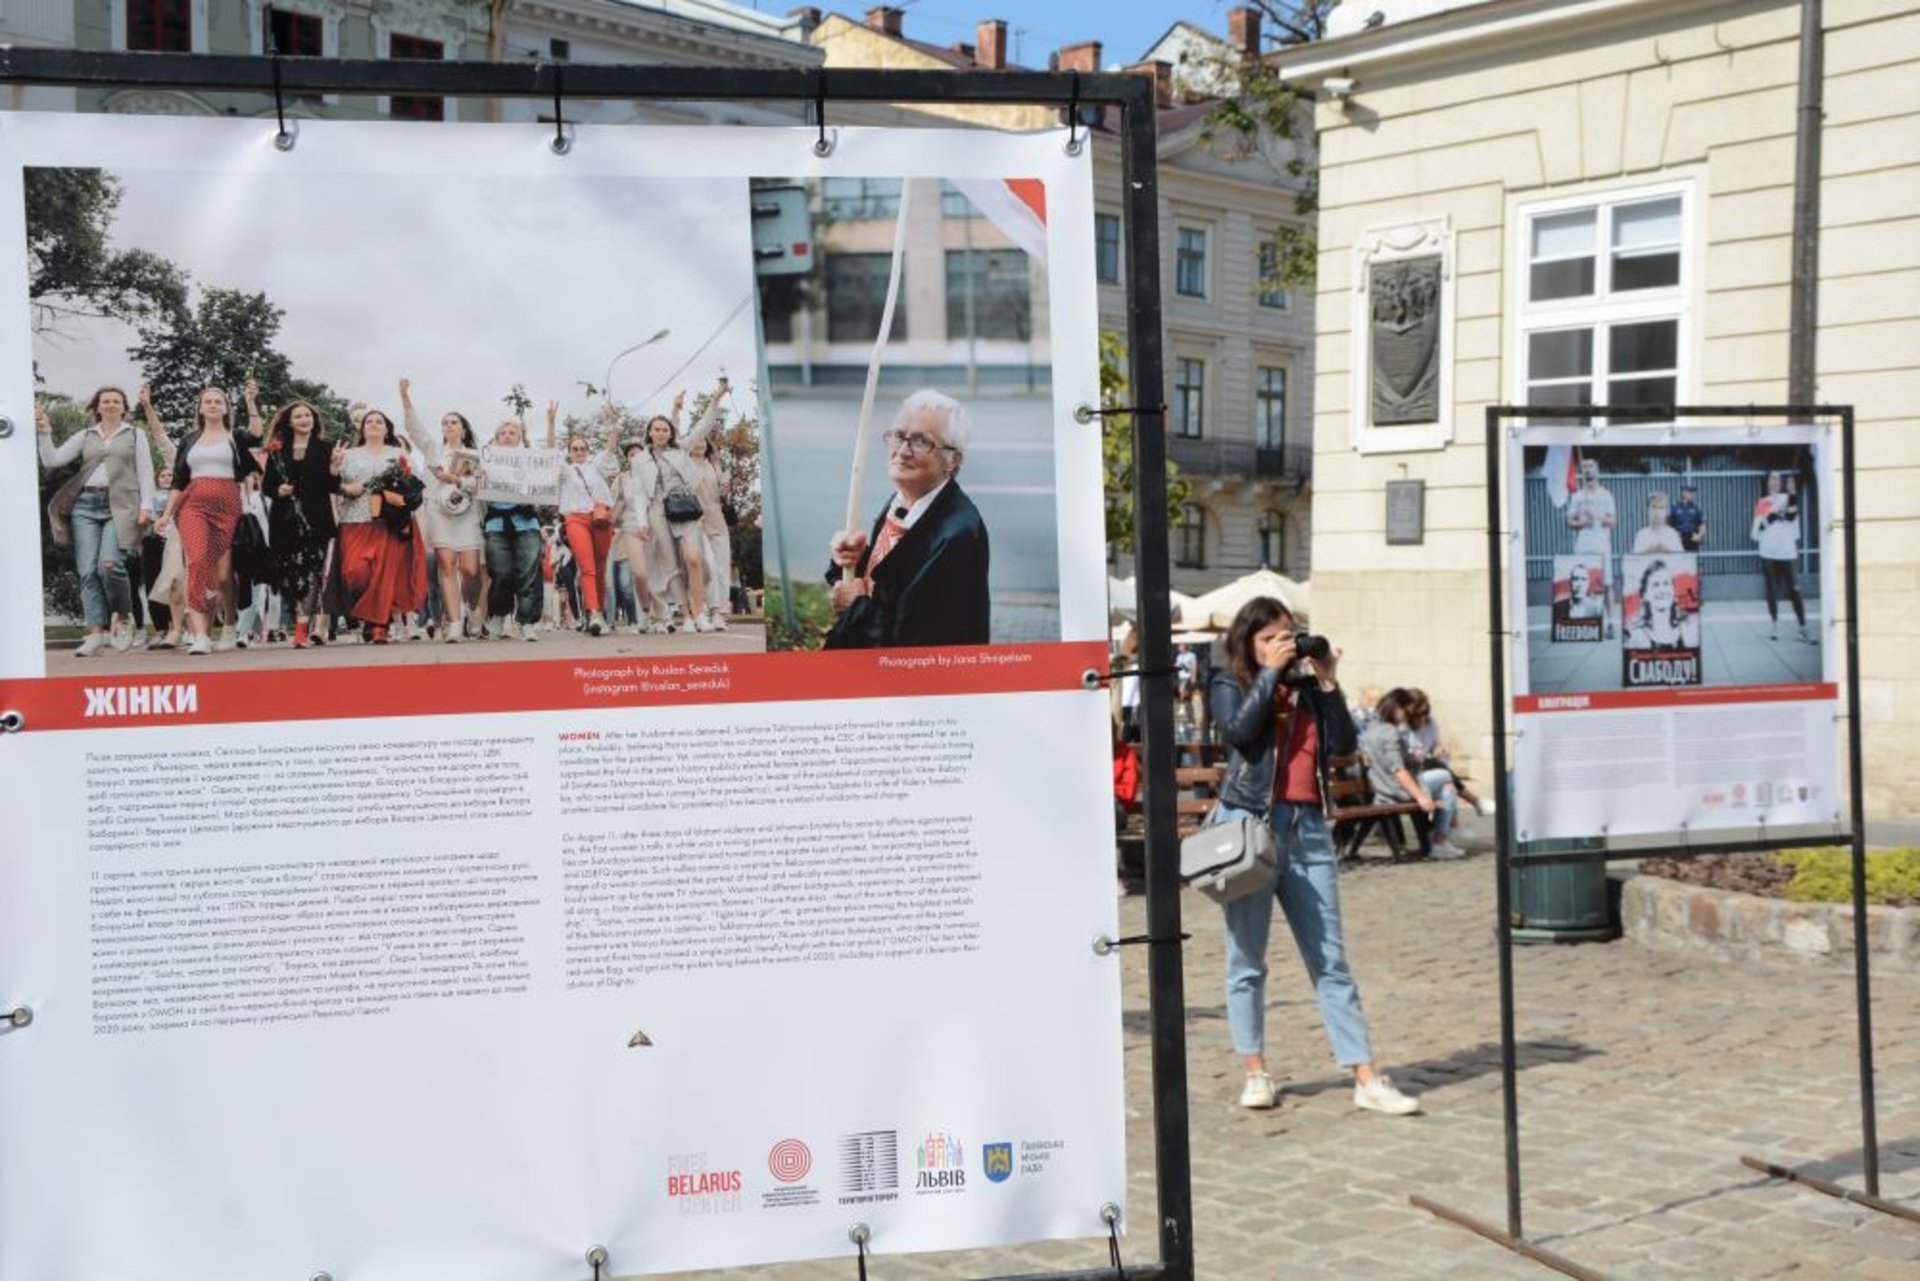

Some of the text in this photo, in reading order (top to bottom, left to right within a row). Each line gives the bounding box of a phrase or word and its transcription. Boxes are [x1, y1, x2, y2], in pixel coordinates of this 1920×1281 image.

[878, 655, 936, 669] Photograph
[938, 654, 951, 667] by
[954, 653, 976, 665] Jana
[574, 668, 635, 680] Photograph
[637, 667, 650, 677] by
[652, 665, 685, 675] Ruslan
[583, 683, 639, 695] (instagram
[84, 684, 198, 717] ЖІНКИ
[559, 732, 600, 741] WOMEN
[668, 1170, 742, 1197] BELARUS
[915, 1169, 966, 1189] ЛЬВІВ
[679, 1194, 742, 1216] CENTER
